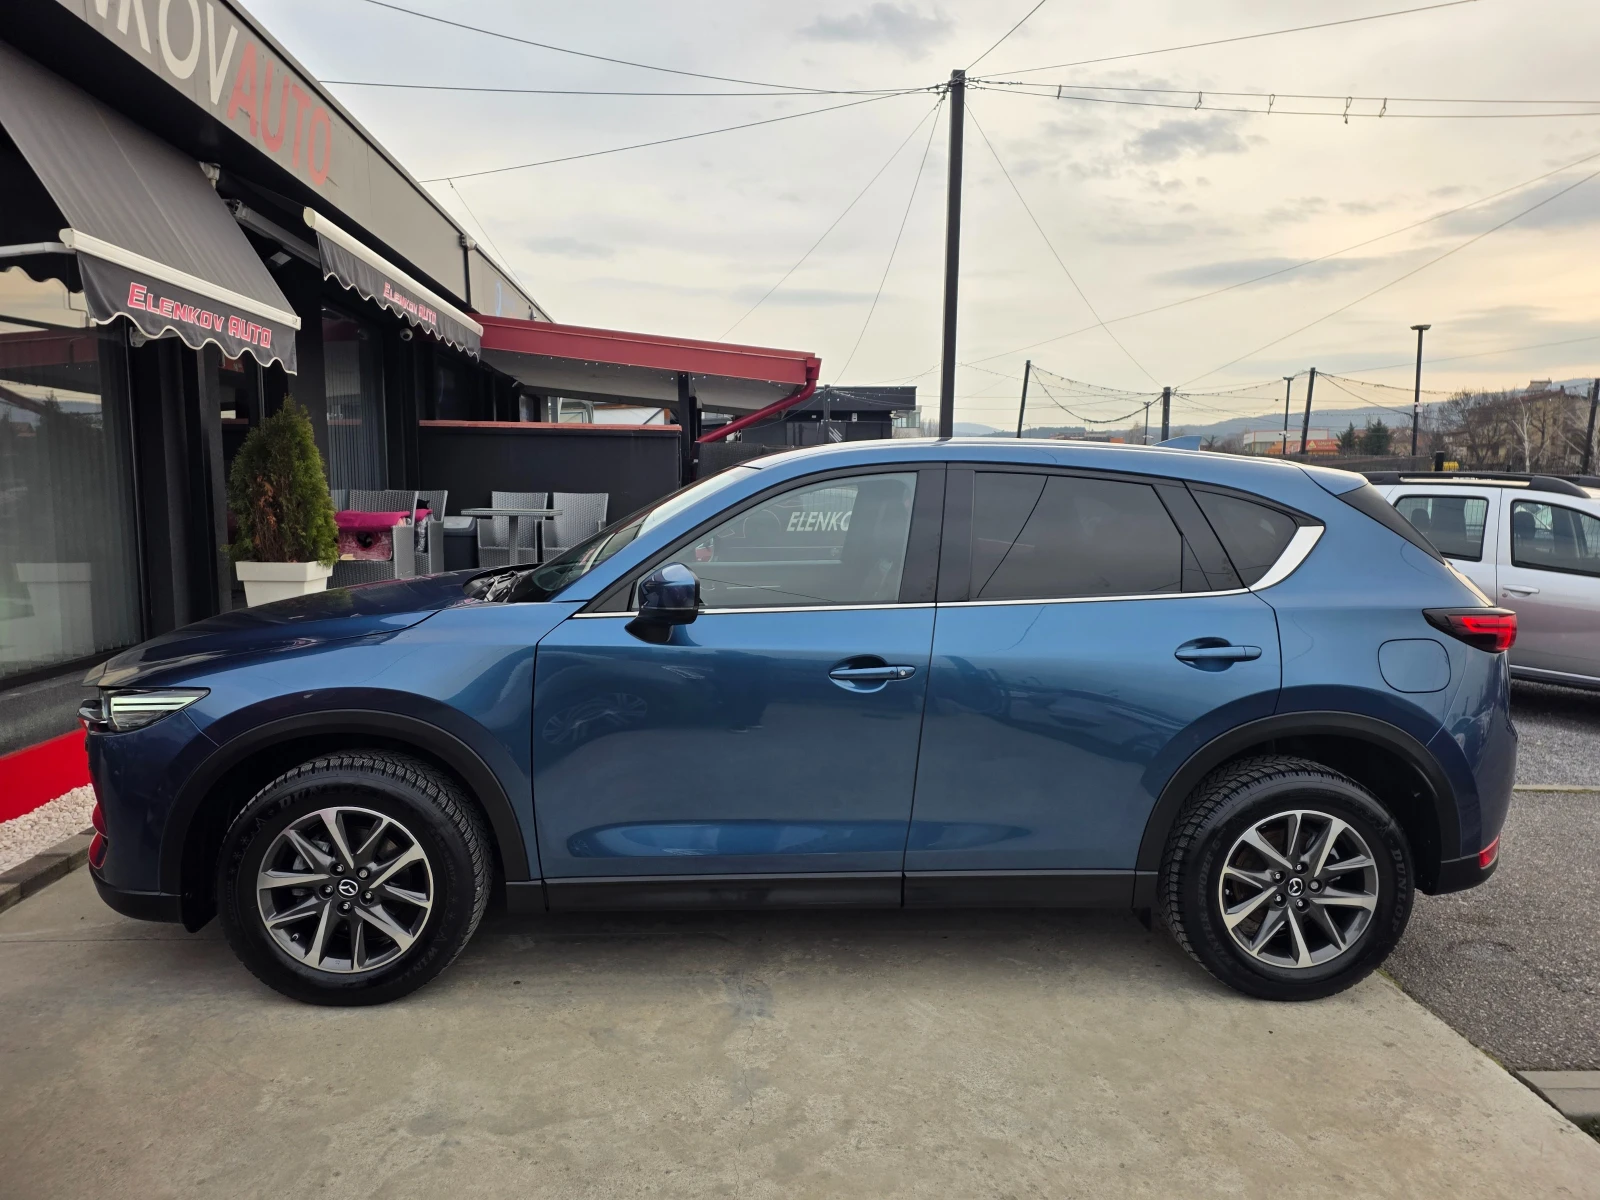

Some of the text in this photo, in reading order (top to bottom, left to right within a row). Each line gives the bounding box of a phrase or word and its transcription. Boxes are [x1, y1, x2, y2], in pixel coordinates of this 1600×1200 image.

[96, 0, 331, 186] OV AUTO
[127, 282, 272, 348] ELENKOV AUTO
[418, 303, 437, 325] AUTO
